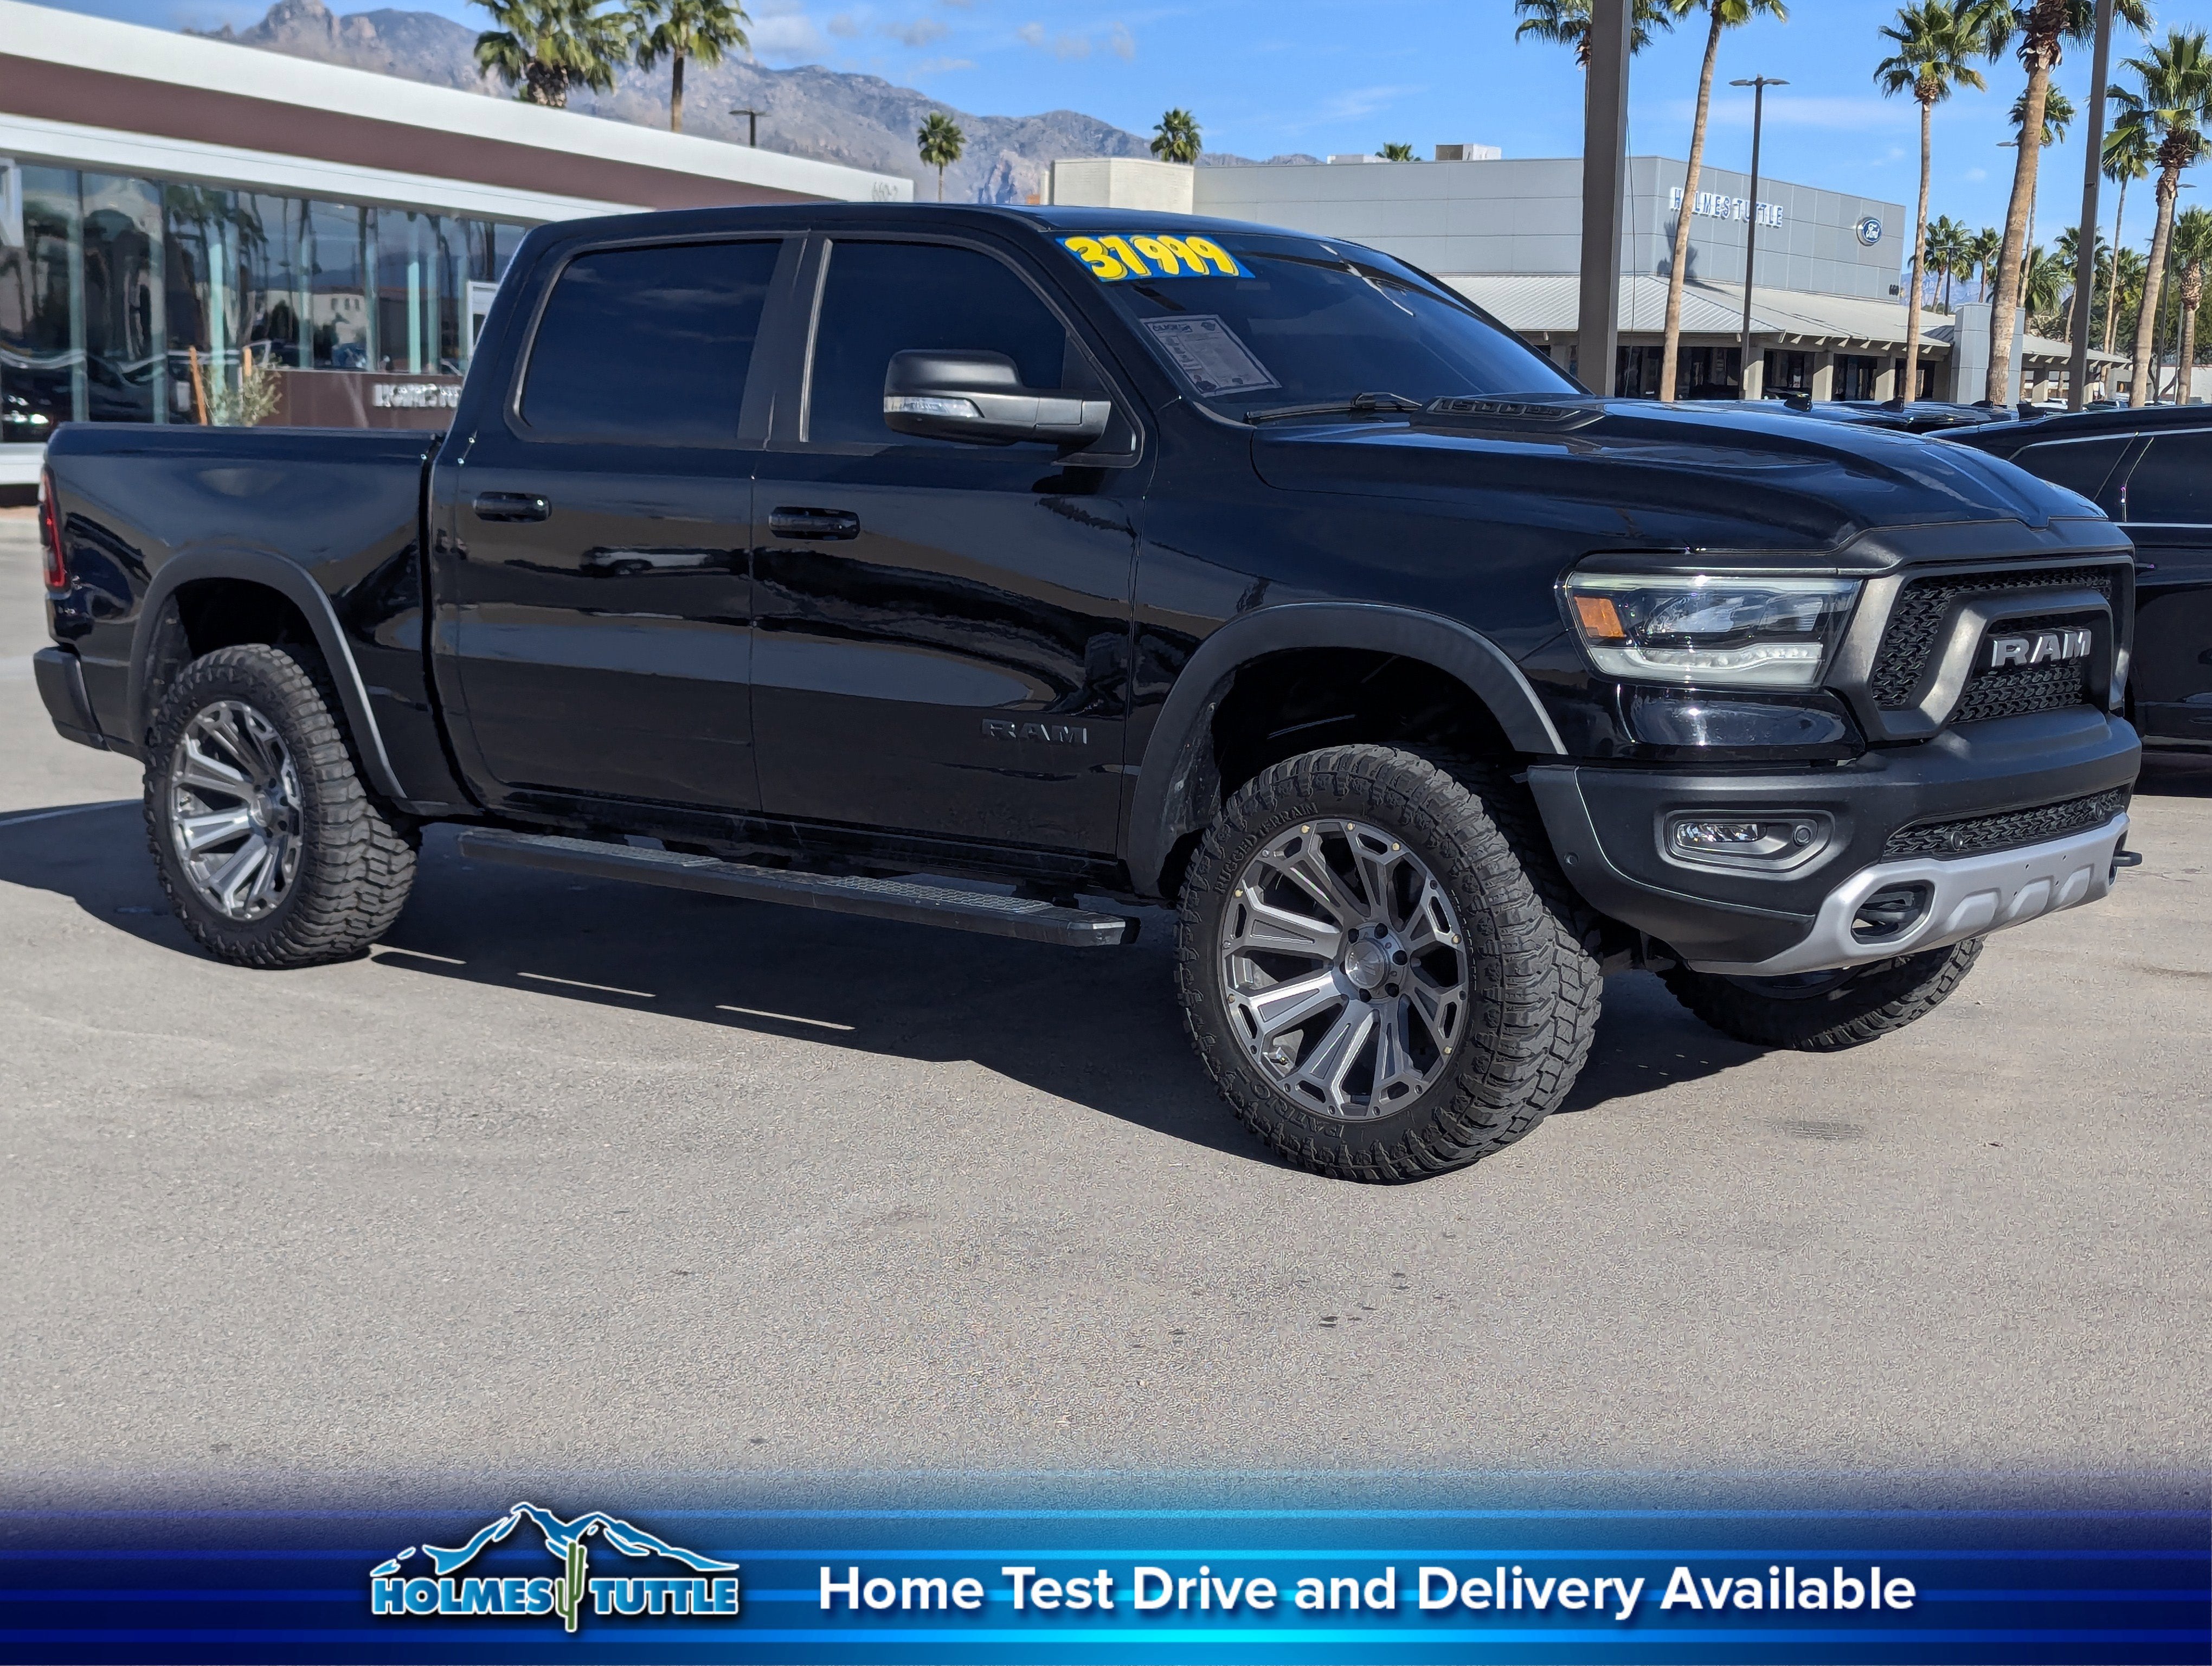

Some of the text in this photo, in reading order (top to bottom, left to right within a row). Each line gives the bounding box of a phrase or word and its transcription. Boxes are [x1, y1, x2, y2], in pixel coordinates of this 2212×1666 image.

[1670, 187, 1731, 219] HLMES
[1065, 236, 1239, 280] 31999
[1991, 627, 2092, 668] RAM
[982, 719, 1088, 745] RAM
[1213, 834, 1258, 894] RUGGED
